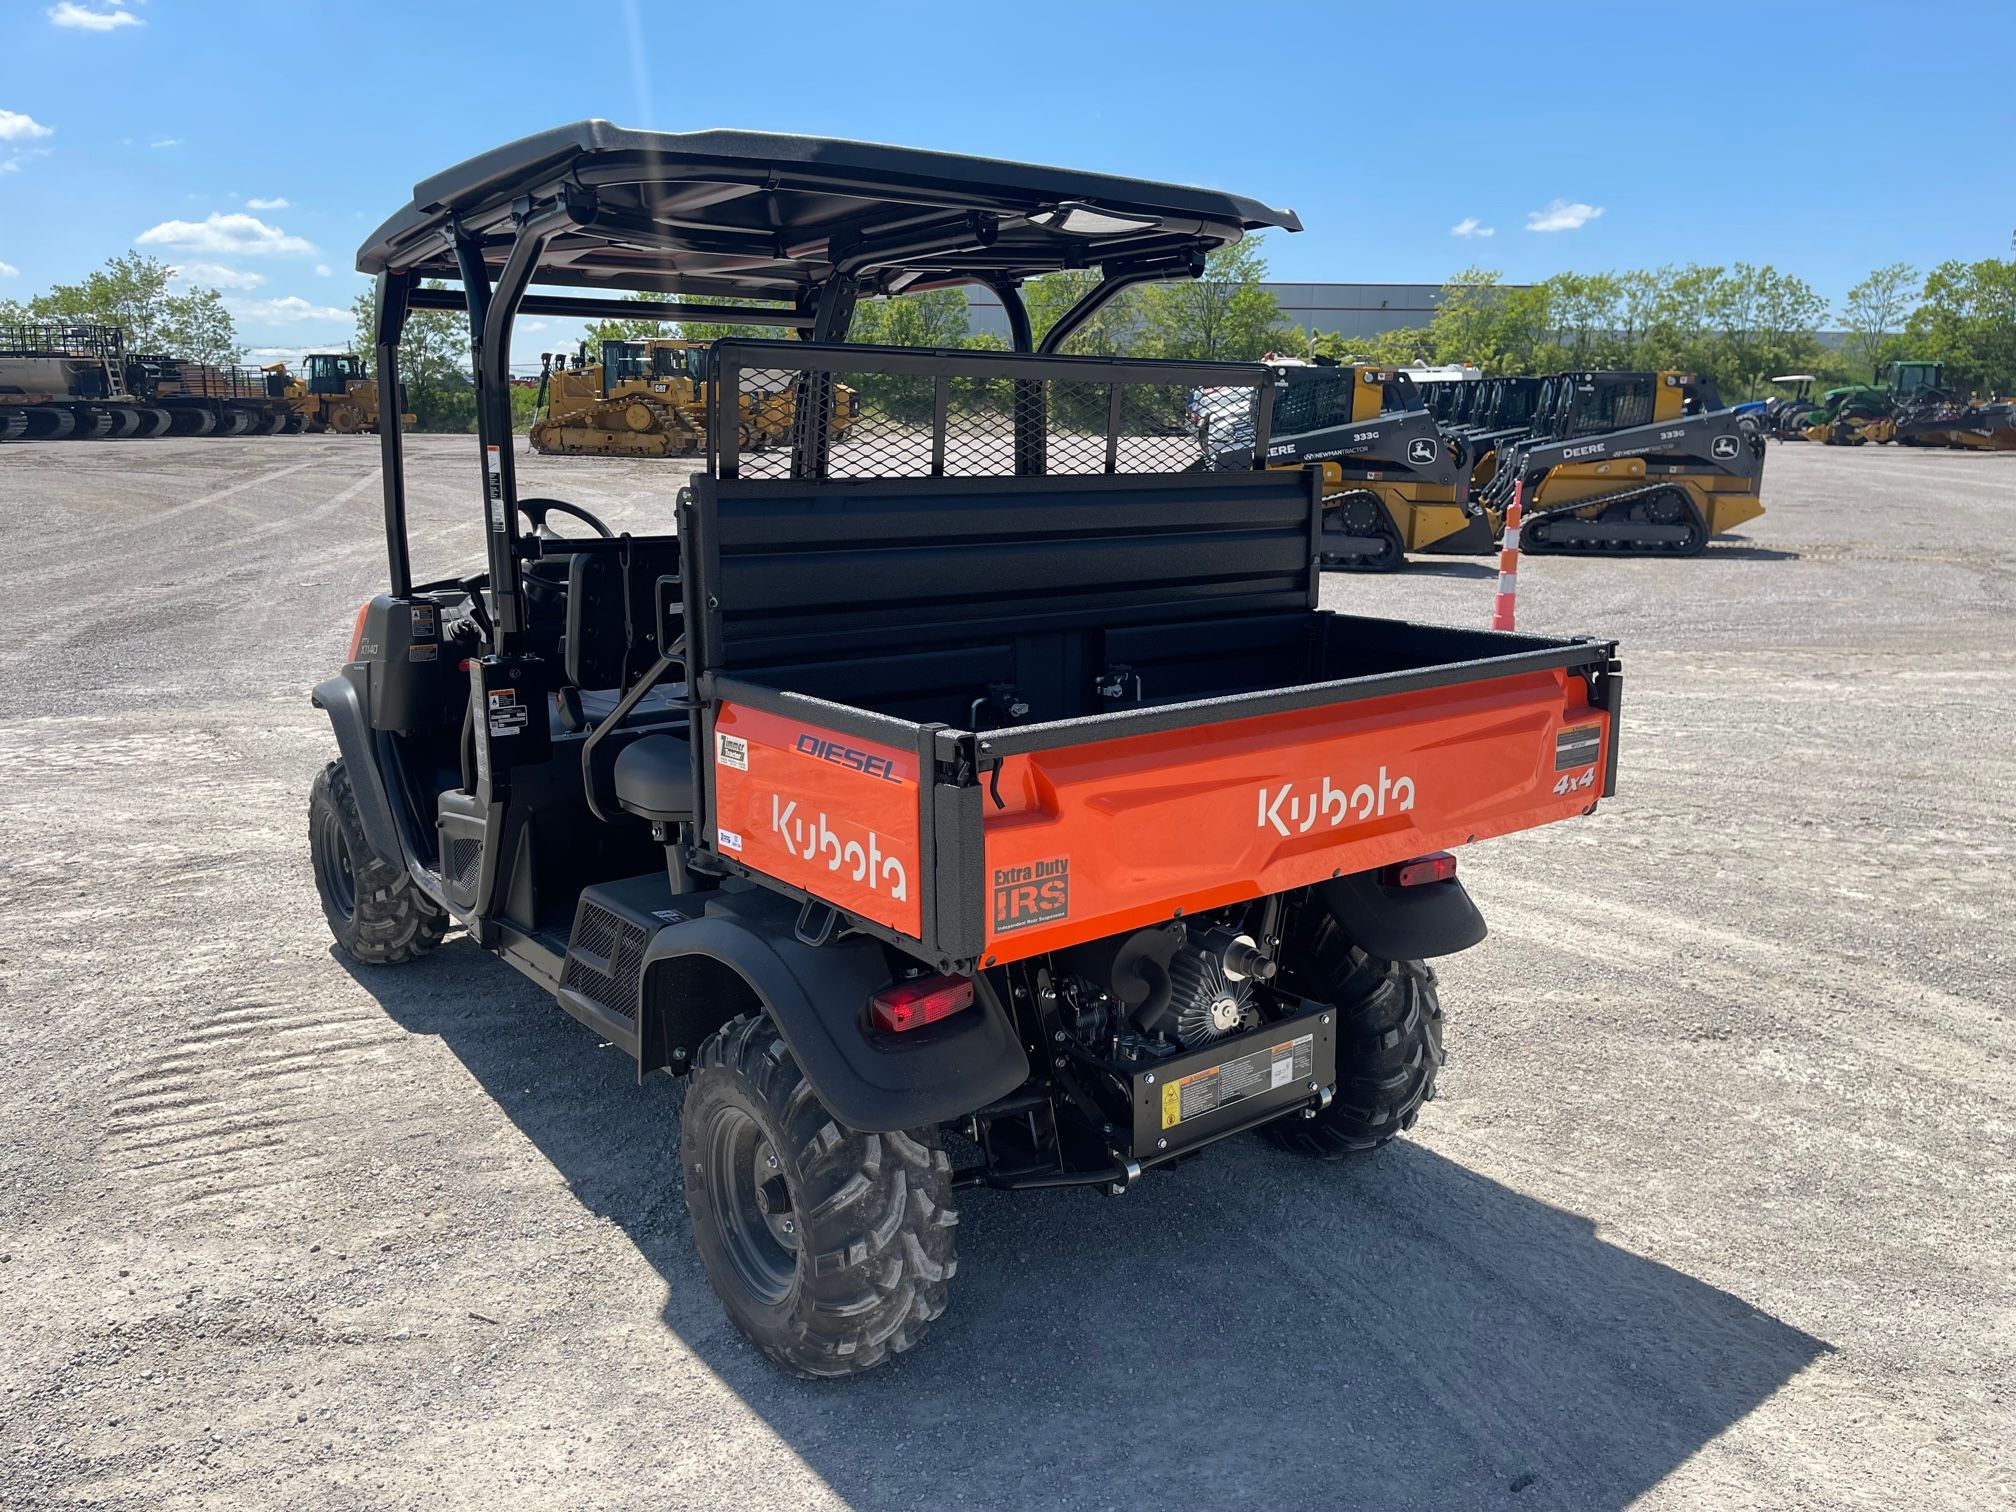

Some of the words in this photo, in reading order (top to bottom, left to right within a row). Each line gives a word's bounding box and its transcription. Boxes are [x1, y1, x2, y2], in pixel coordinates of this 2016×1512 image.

[655, 384, 667, 393] CAT
[1353, 431, 1380, 442] 333G
[1660, 429, 1685, 441] 333G
[1562, 443, 1606, 459] DEERE
[796, 733, 903, 784] DIESEL
[1552, 767, 1595, 796] 4x4
[1256, 765, 1416, 838] Kubota
[772, 793, 907, 903] Kubota
[994, 866, 1032, 886] Extra
[1035, 859, 1068, 878] Duty
[997, 880, 1066, 922] IRS
[997, 920, 1026, 931] Independent
